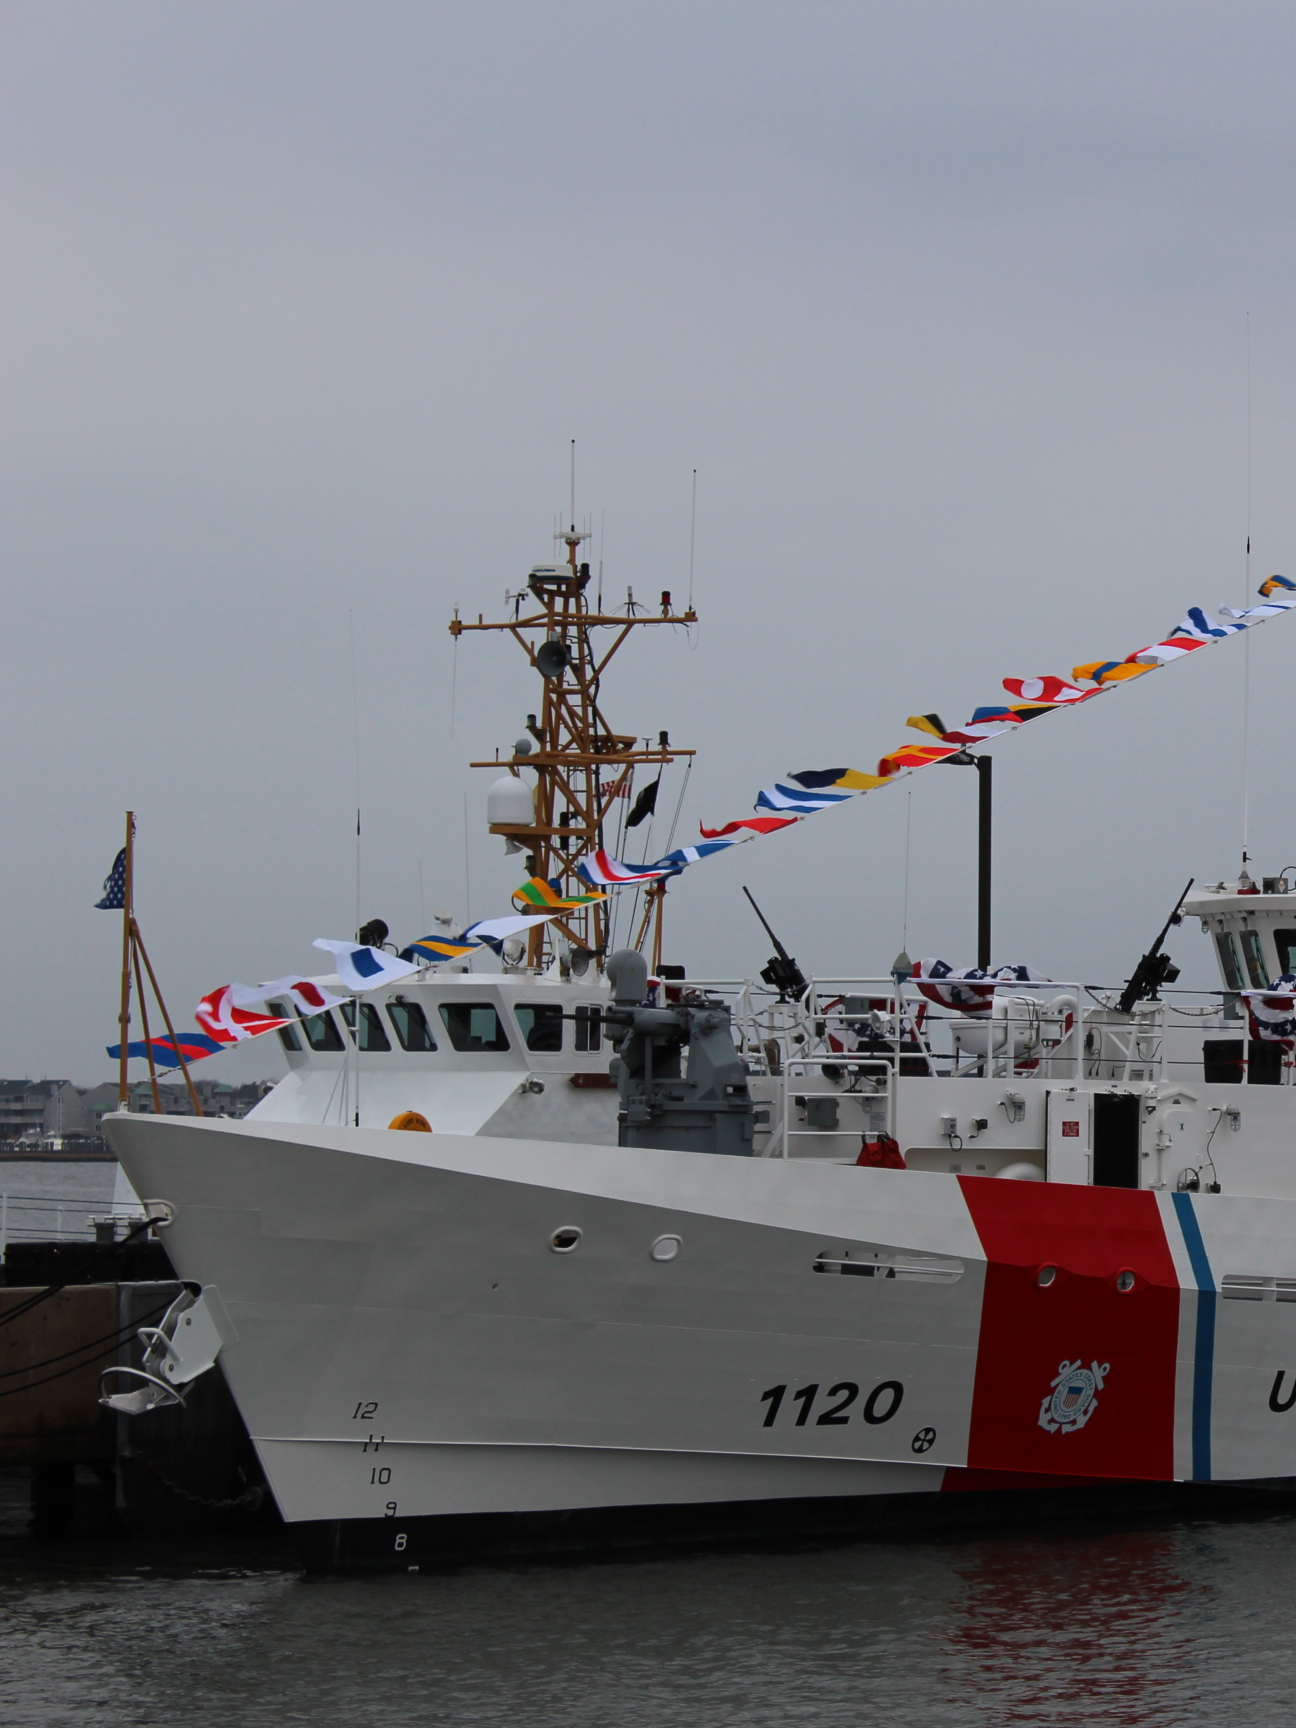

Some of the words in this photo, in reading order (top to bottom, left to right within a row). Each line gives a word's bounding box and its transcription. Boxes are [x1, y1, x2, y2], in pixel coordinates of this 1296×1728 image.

[352, 1402, 378, 1420] 12
[760, 1380, 904, 1428] 1120
[362, 1434, 385, 1453] 11
[370, 1467, 392, 1485] 10
[384, 1501, 398, 1519] 9
[394, 1533, 408, 1551] 8
